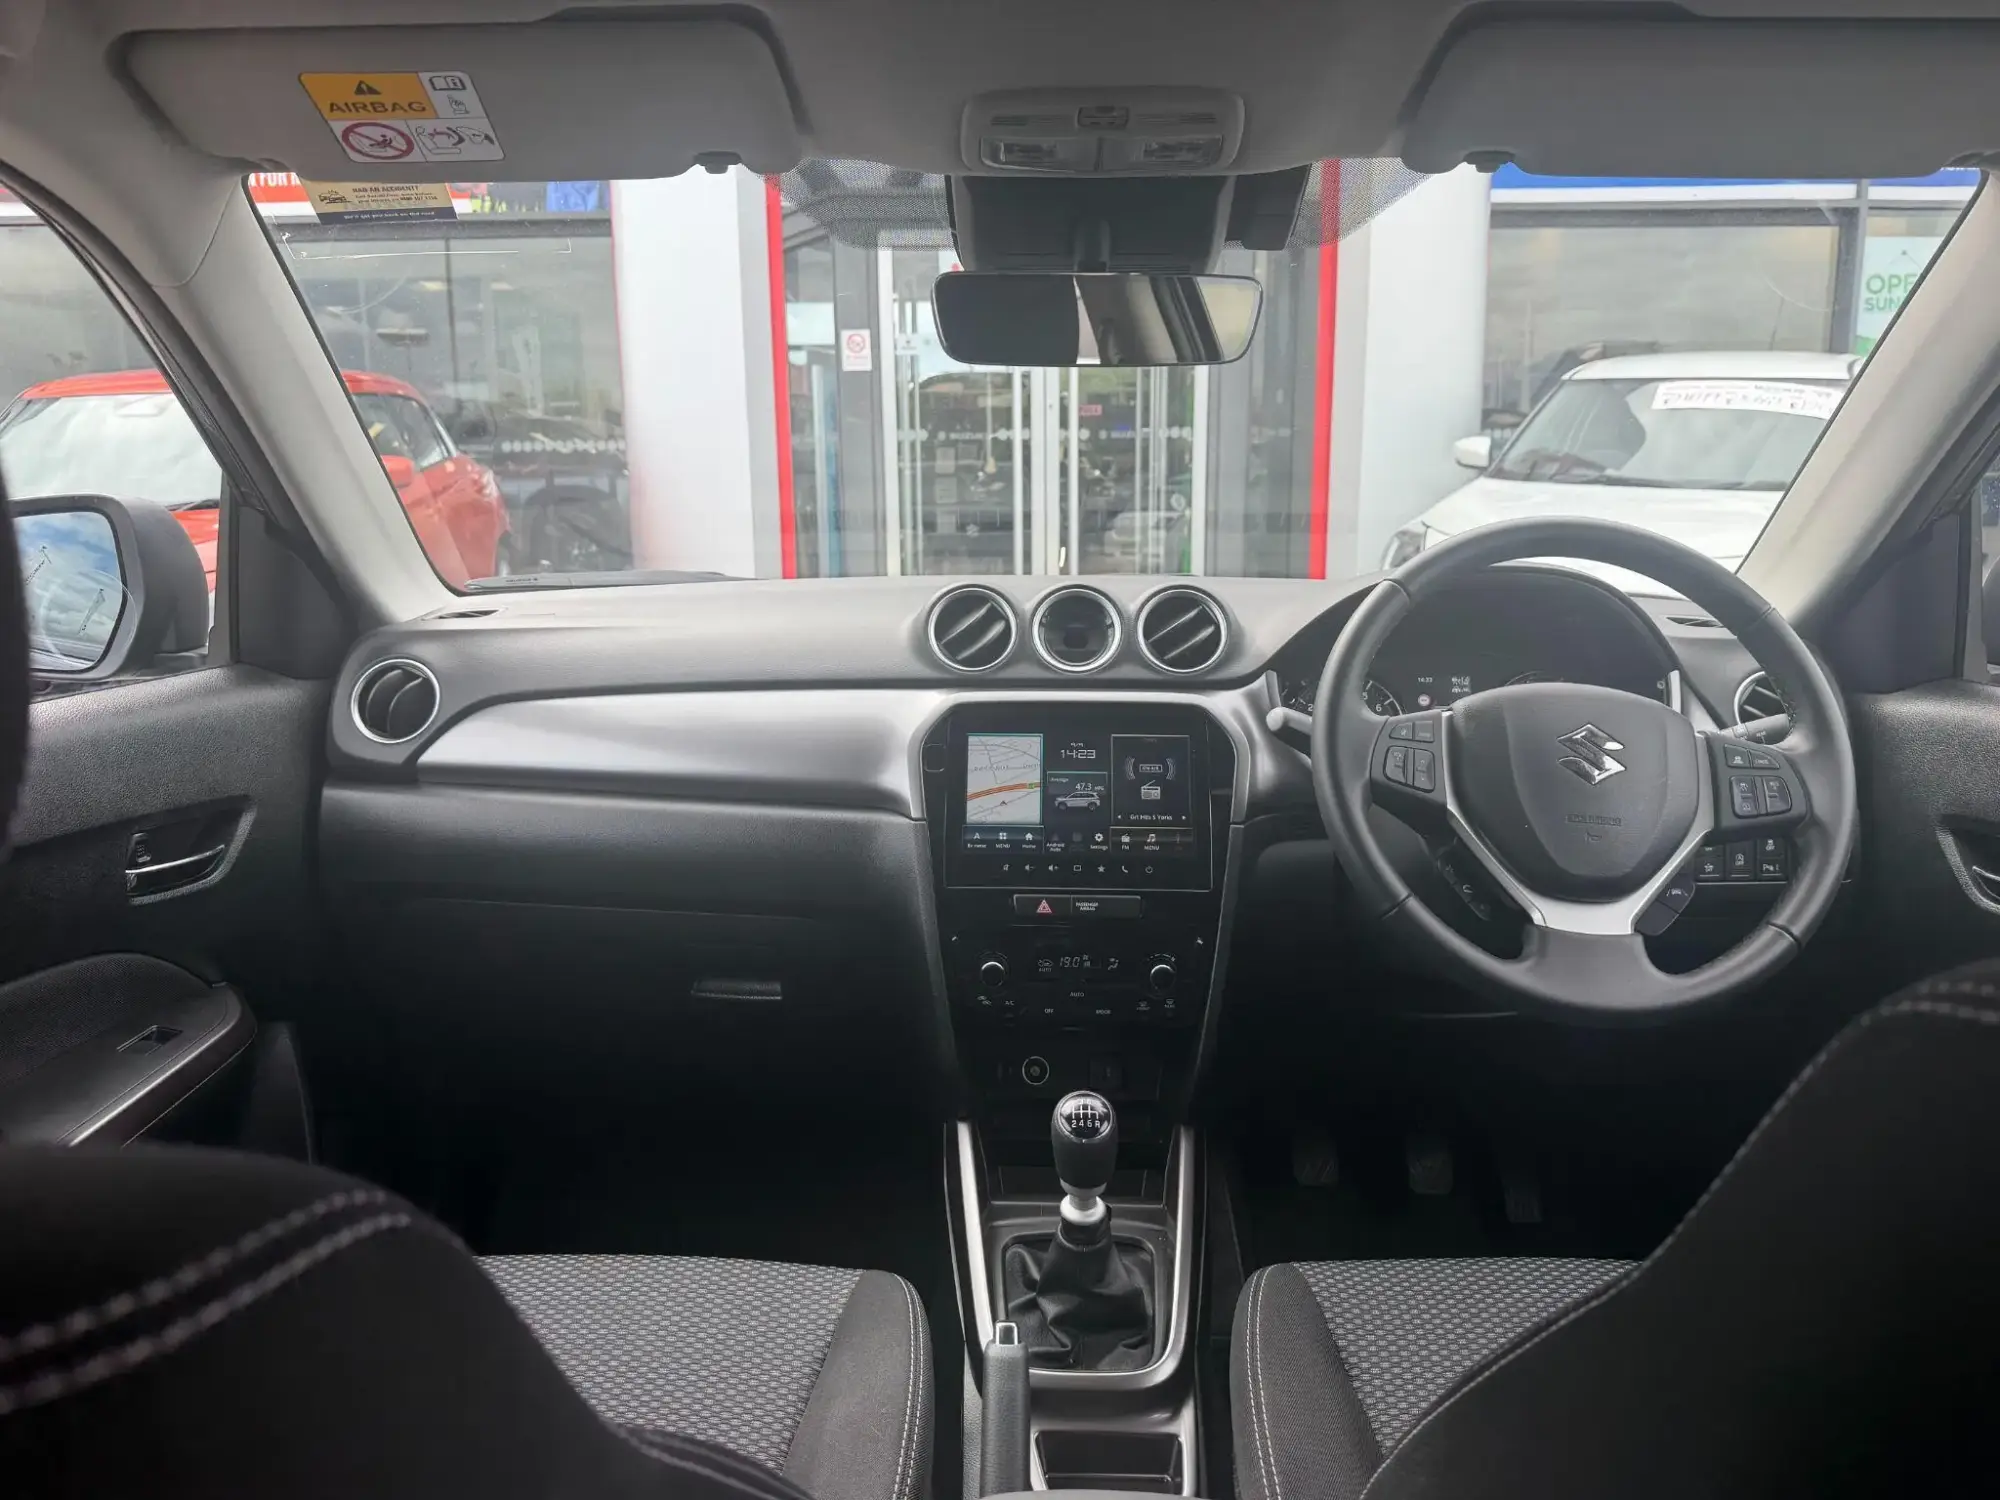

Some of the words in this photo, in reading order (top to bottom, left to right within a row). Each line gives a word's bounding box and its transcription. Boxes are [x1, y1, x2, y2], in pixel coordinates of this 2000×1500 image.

[329, 102, 427, 113] AIRBAG
[1375, 703, 1382, 712] 6
[1060, 749, 1096, 759] 14:23
[1075, 783, 1092, 791] 47.3
[1071, 1120, 1077, 1128] 2
[1078, 1120, 1084, 1128] 4
[1087, 1120, 1092, 1128] 6
[1094, 1120, 1100, 1129] R
